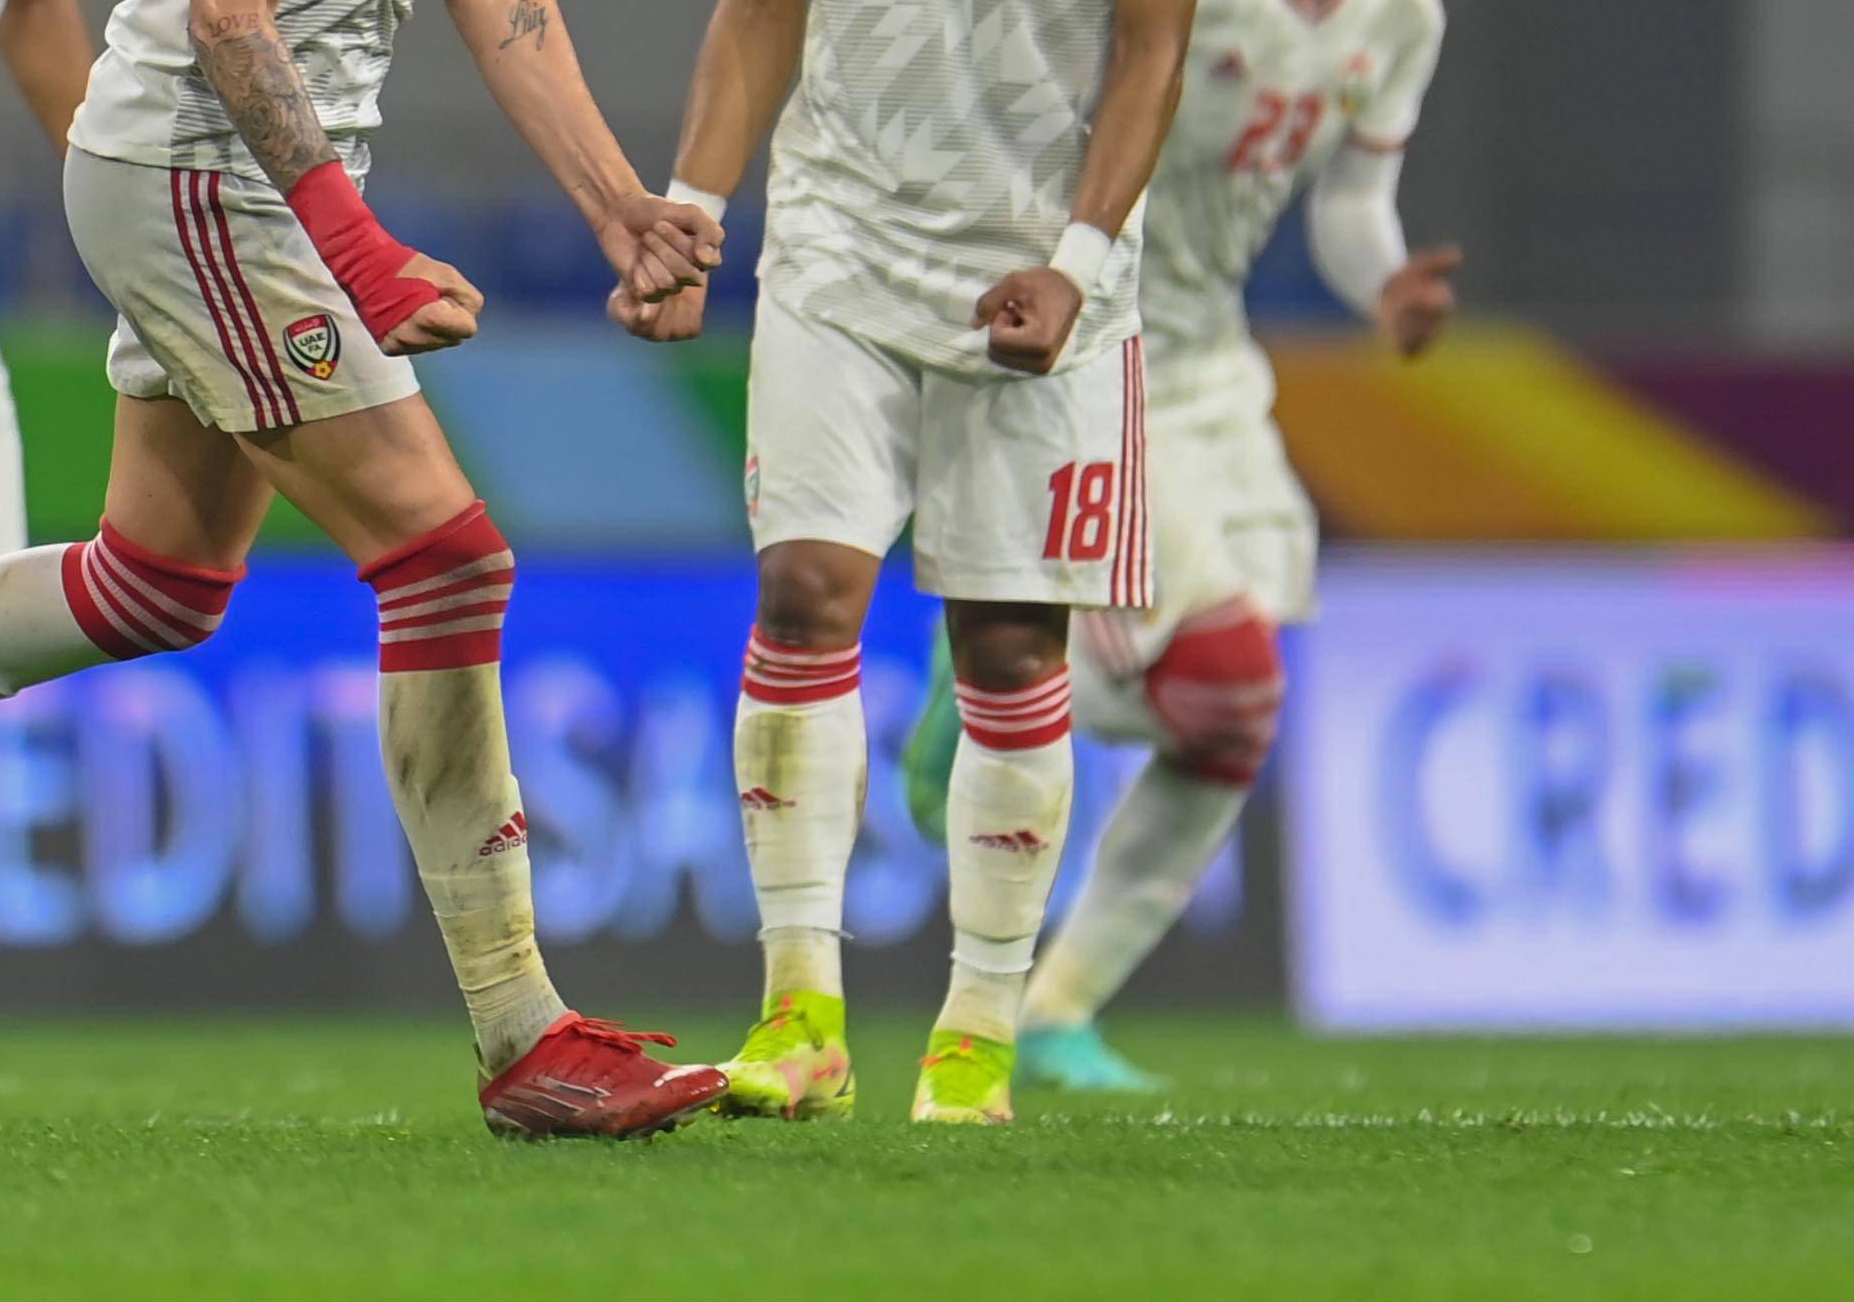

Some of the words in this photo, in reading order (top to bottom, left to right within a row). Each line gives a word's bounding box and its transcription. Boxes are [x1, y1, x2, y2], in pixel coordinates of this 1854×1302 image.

[210, 12, 260, 38] LOVE
[1226, 91, 1324, 174] 23
[299, 332, 326, 347] UAE
[1042, 460, 1116, 562] 18
